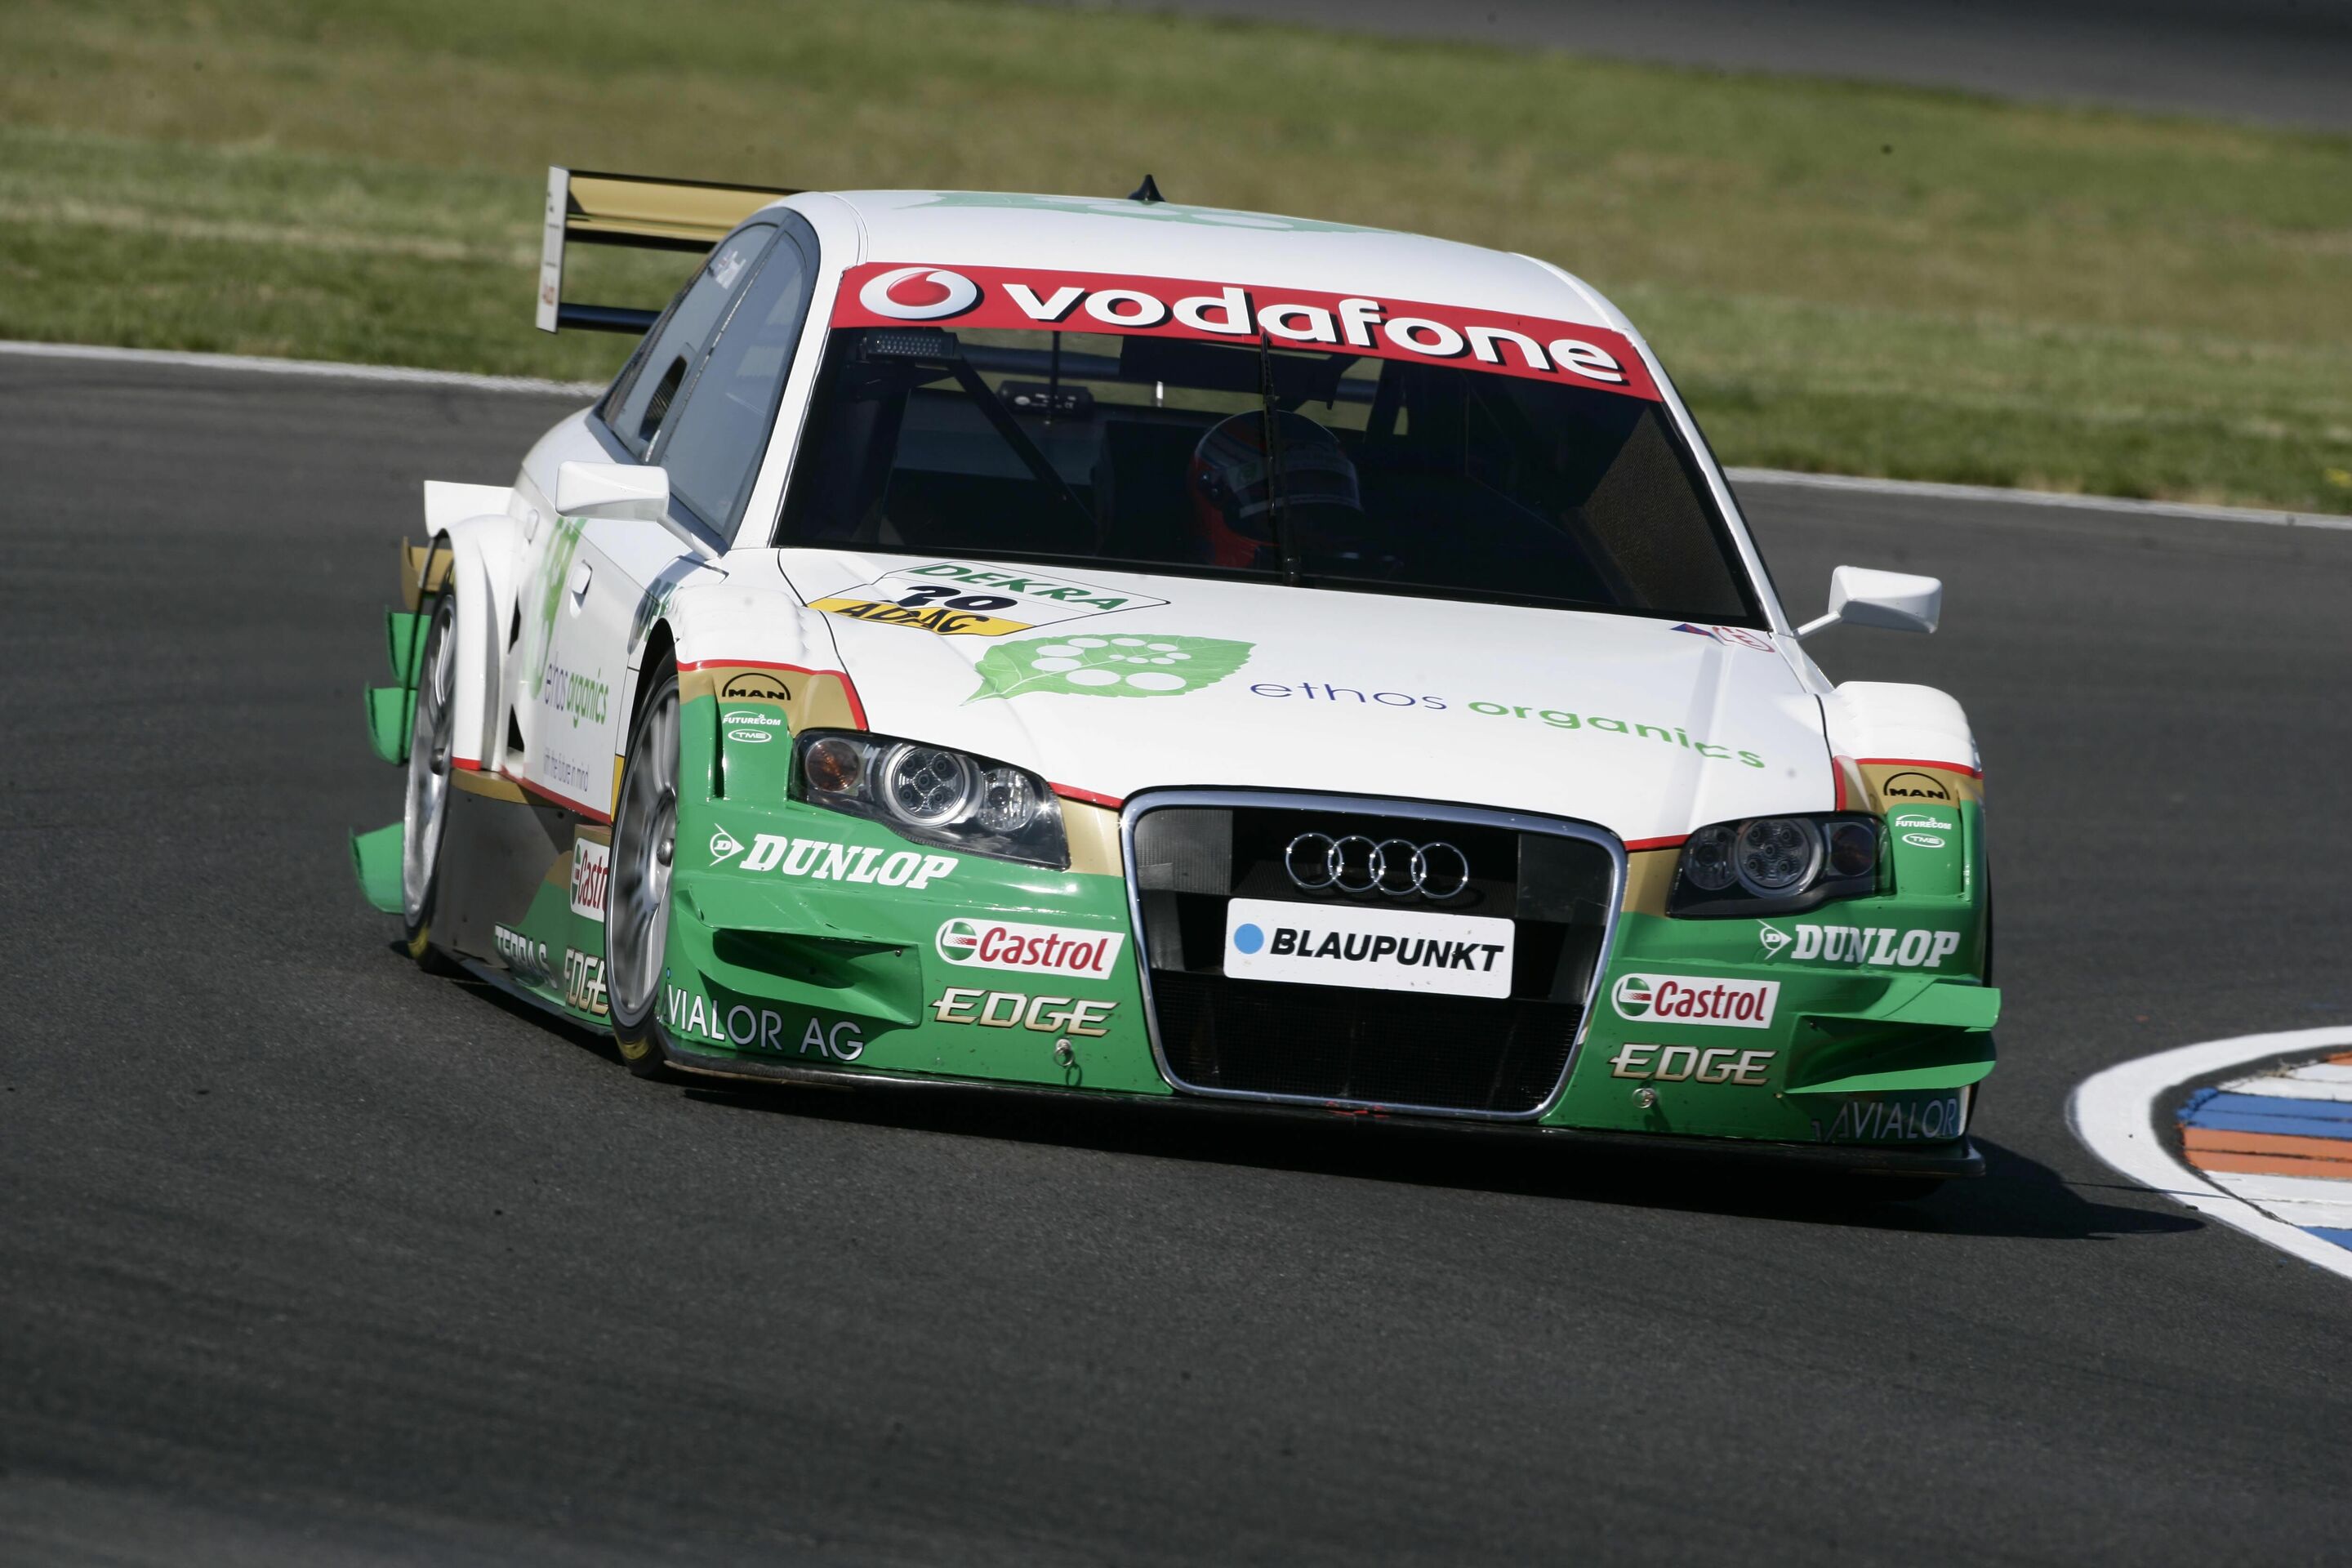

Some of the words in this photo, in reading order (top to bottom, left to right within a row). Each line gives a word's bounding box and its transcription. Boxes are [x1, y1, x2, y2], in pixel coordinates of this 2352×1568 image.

[1000, 282, 1625, 383] vodafone
[906, 564, 1129, 612] DEKRA
[833, 601, 990, 635] ADAC
[567, 667, 609, 728] organics
[728, 688, 786, 701] MAN
[723, 717, 782, 726] FUTURECOM
[736, 732, 767, 740] TME
[1250, 681, 1448, 710] ethos
[1468, 700, 1766, 769] organics
[1888, 787, 1945, 800] MAN
[1895, 820, 1953, 830] FUTURECOM
[1909, 835, 1941, 844] TME
[739, 833, 959, 890] DUNLOP
[979, 926, 1109, 972] Castrol
[1270, 928, 1504, 972] BLAUPUNKT
[1791, 924, 1961, 968] DUNLOP
[929, 986, 1120, 1037] EDGE
[1654, 981, 1767, 1022] Castrol
[800, 1016, 864, 1061] AG
[1608, 1042, 1779, 1086] EDGE
